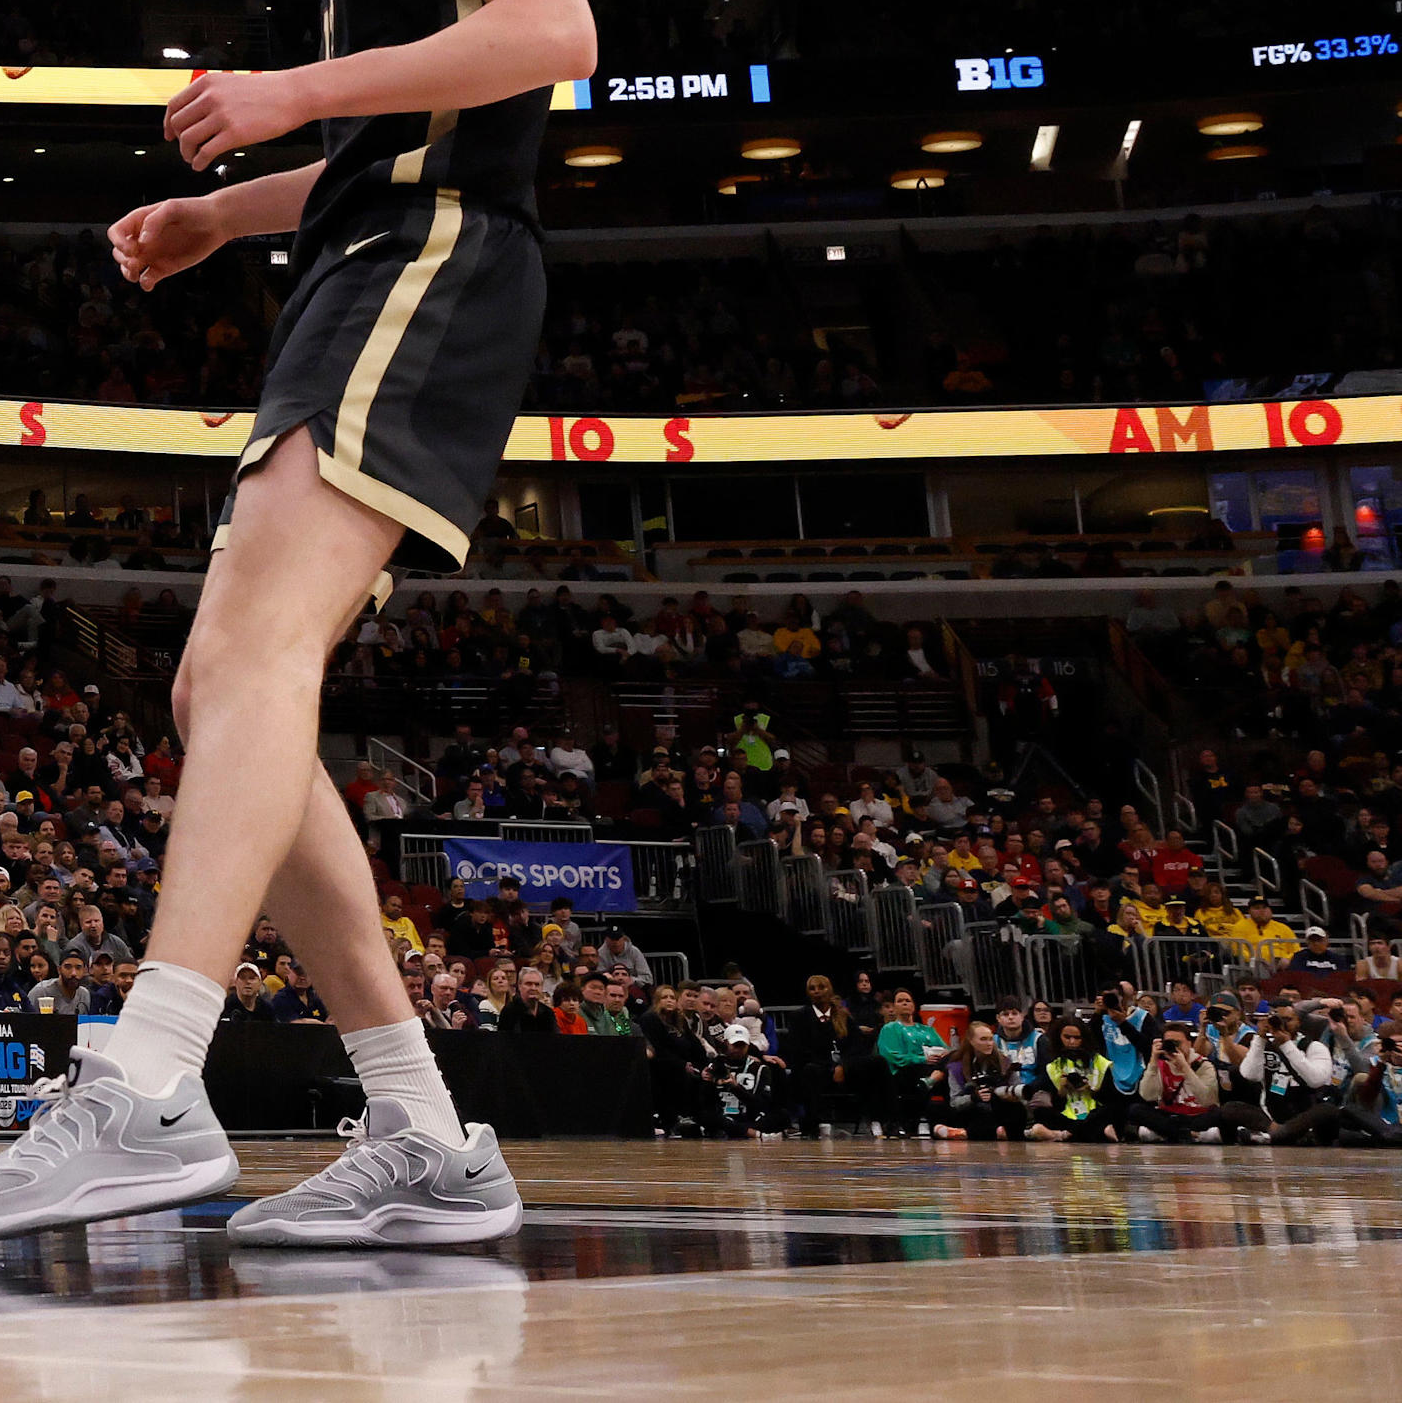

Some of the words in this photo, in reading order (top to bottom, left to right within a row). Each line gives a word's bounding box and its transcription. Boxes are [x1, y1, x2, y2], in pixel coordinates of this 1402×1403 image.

[1253, 43, 1312, 66] FG%
[1314, 34, 1400, 62] 33.3%
[608, 75, 676, 101] 2:58
[682, 74, 728, 99] PM
[955, 56, 1045, 91] B1G
[827, 247, 846, 258] EXIT
[21, 403, 47, 447] S
[550, 418, 616, 462] IO
[665, 419, 695, 463] S
[1110, 407, 1215, 454] AM
[1264, 401, 1344, 448] IO
[529, 864, 622, 889] SPORTS
